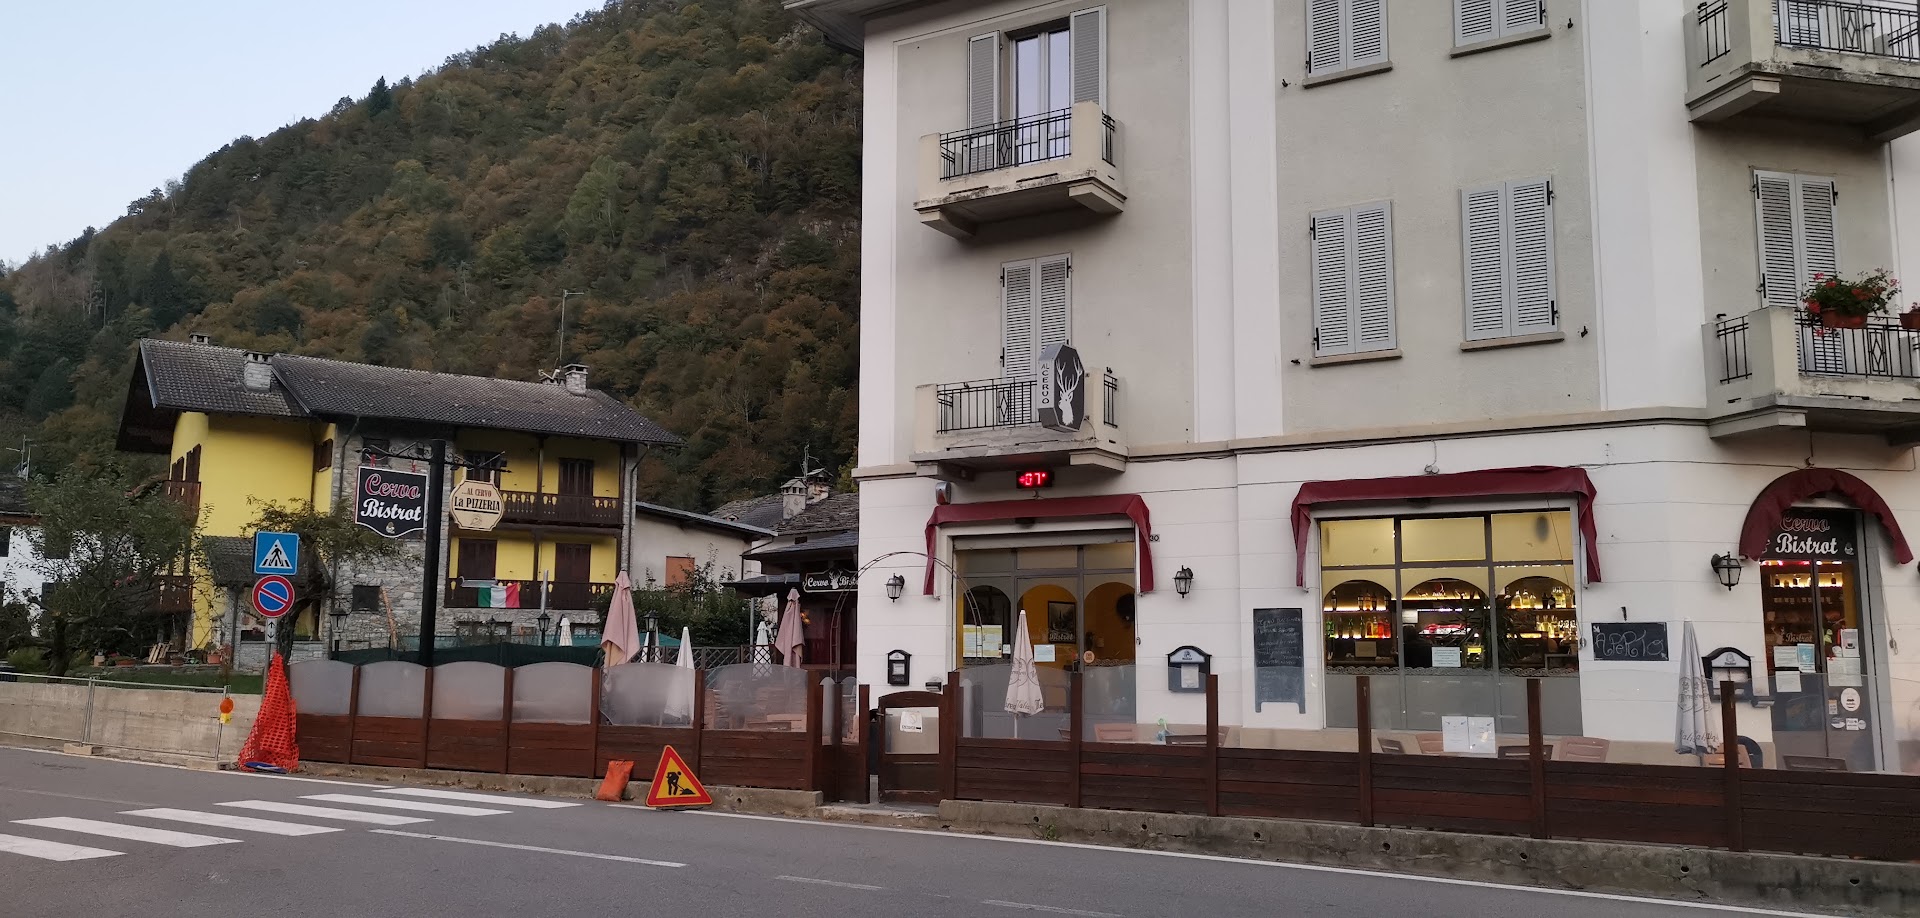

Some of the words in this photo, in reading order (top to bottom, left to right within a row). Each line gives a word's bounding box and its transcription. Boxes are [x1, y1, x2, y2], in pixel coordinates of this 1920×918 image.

[365, 473, 420, 499] Cervo
[475, 488, 492, 498] CERVO
[360, 498, 421, 521] Bistrot
[454, 496, 464, 508] La
[466, 497, 500, 511] PIZZERIA
[1780, 511, 1830, 532] Cervo
[1775, 533, 1838, 554] Bistrot
